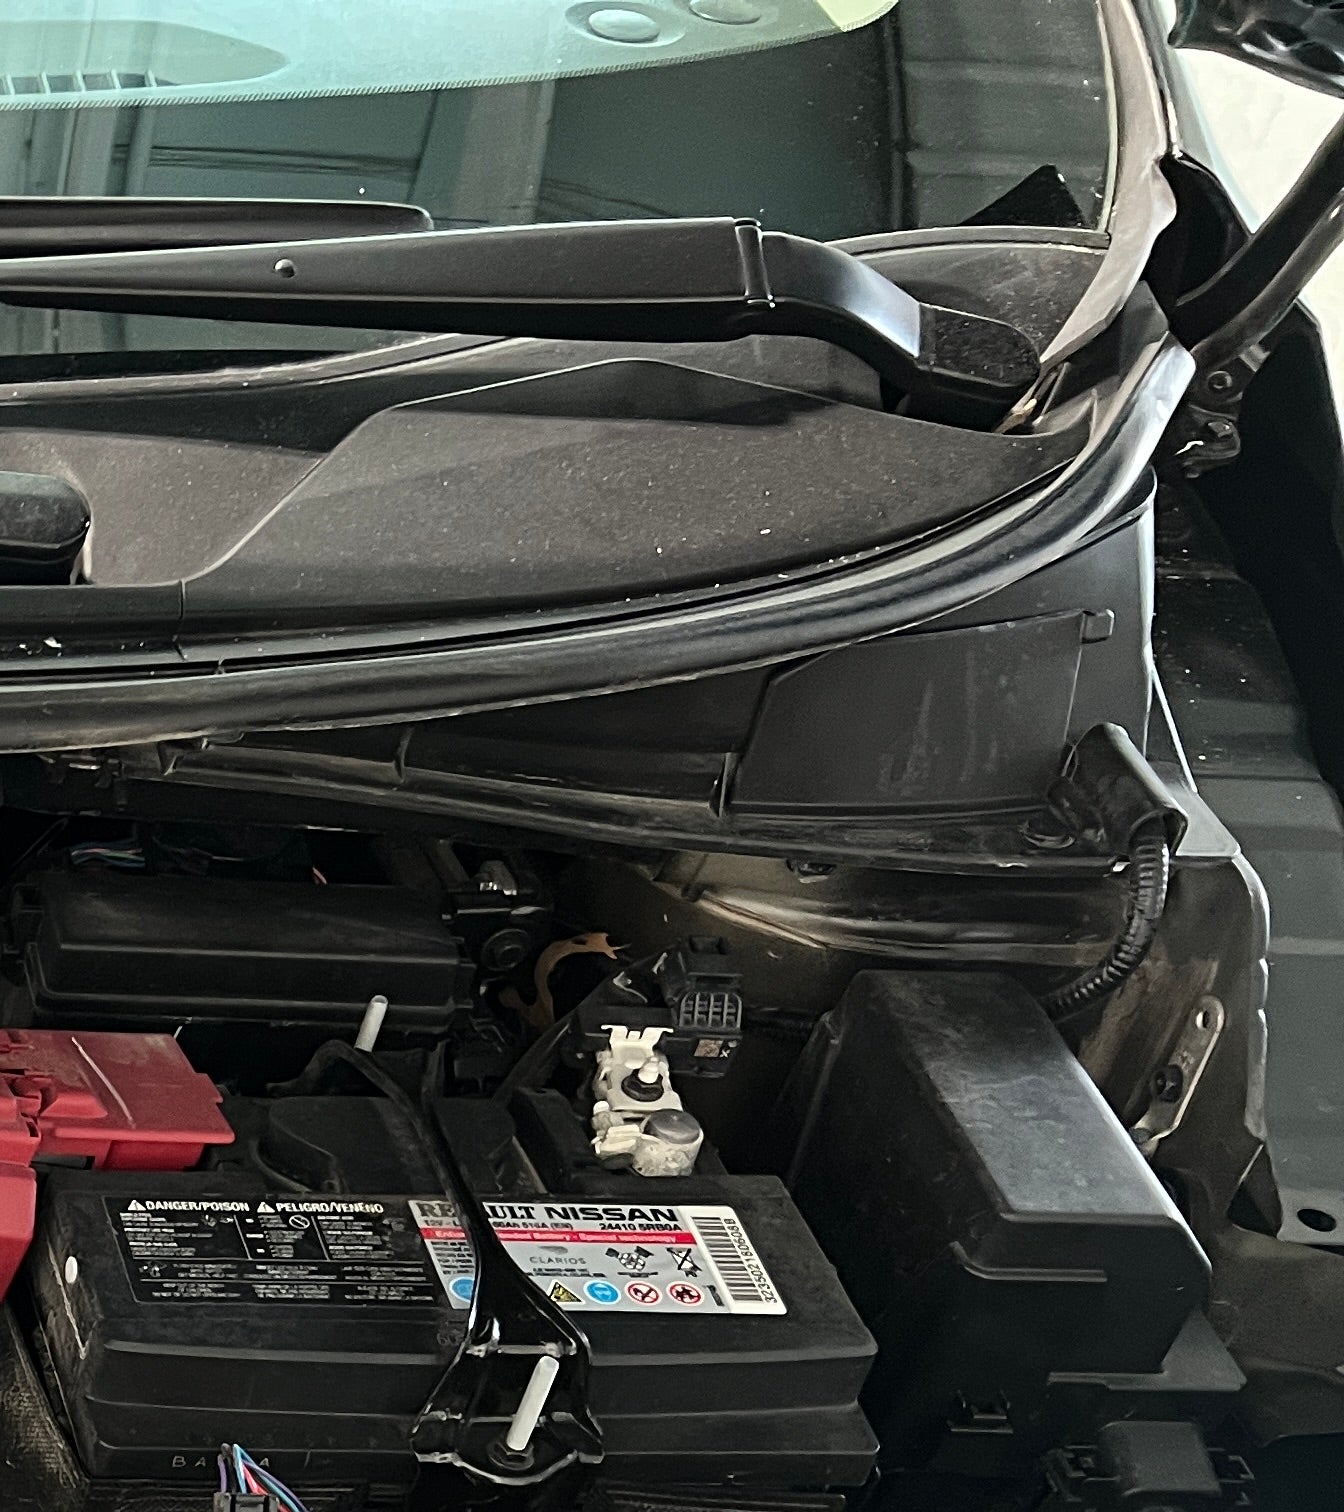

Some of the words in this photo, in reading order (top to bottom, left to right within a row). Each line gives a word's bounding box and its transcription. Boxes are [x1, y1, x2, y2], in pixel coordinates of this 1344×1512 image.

[145, 1200, 250, 1212] DANGER/POISON
[544, 1206, 679, 1222] NISSAN
[599, 1222, 636, 1232] 24410
[529, 1256, 587, 1265] CLARIOS
